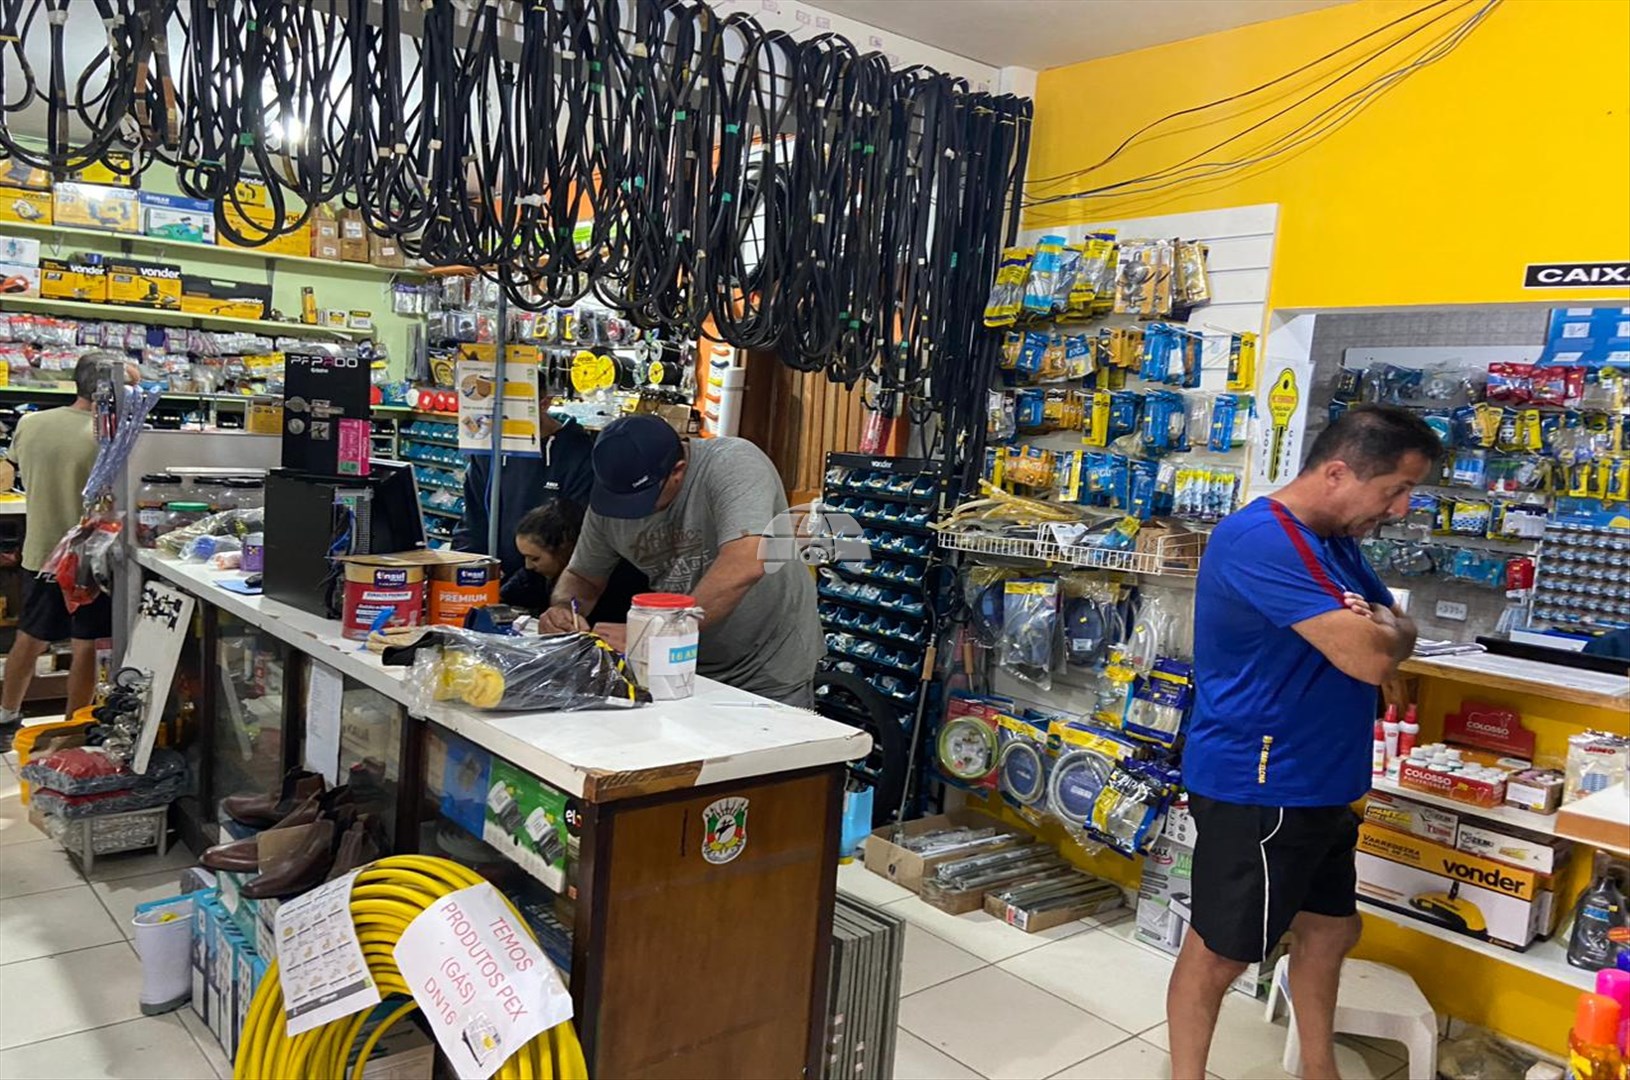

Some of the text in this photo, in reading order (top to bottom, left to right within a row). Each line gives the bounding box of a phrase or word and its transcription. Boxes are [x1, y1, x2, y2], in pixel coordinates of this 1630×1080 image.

[70, 264, 105, 275] vonder
[139, 267, 182, 279] vonder
[1537, 266, 1630, 283] CAIX
[440, 593, 488, 603] PREMIUM
[1466, 721, 1510, 736] COLOSSO
[1404, 768, 1452, 786] COLOSSO
[1442, 859, 1526, 894] vonder
[489, 916, 534, 972] TEMOS
[440, 901, 529, 1022] PRODUTOS PEX
[424, 977, 457, 1025] DN16
